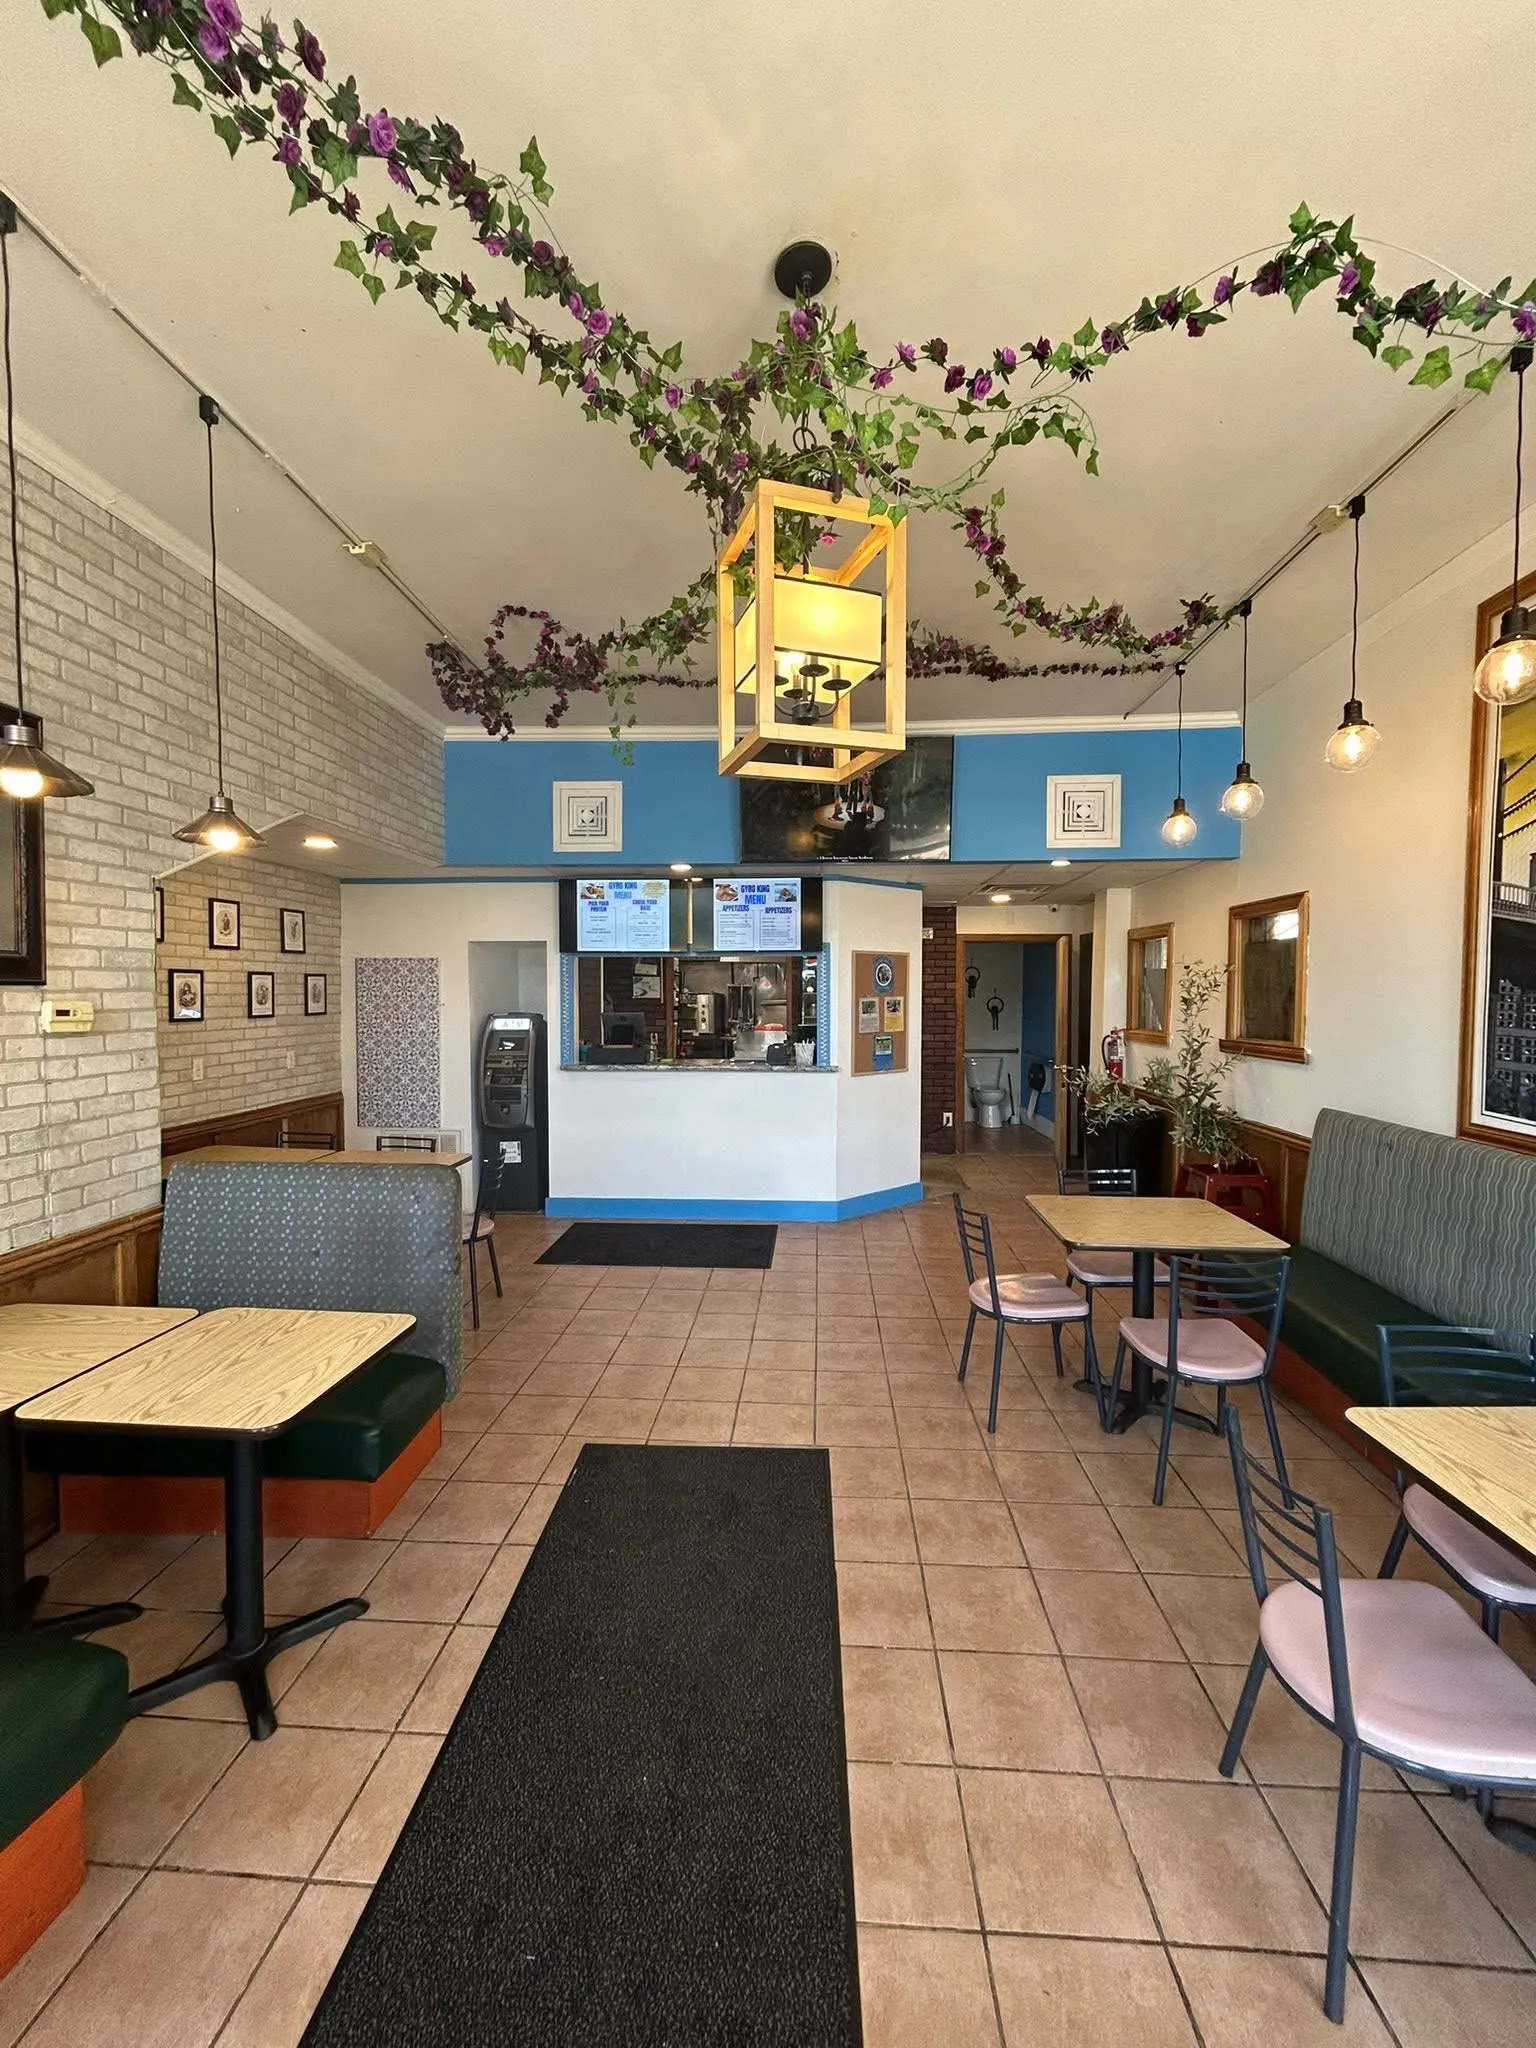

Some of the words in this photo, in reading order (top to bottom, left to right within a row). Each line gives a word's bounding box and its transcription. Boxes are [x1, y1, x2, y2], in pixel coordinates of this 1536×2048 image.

[608, 882, 623, 890] GYRO
[624, 882, 638, 890] KING
[741, 884, 756, 893] GYRO
[757, 884, 770, 893] KING
[744, 894, 766, 904] MENU
